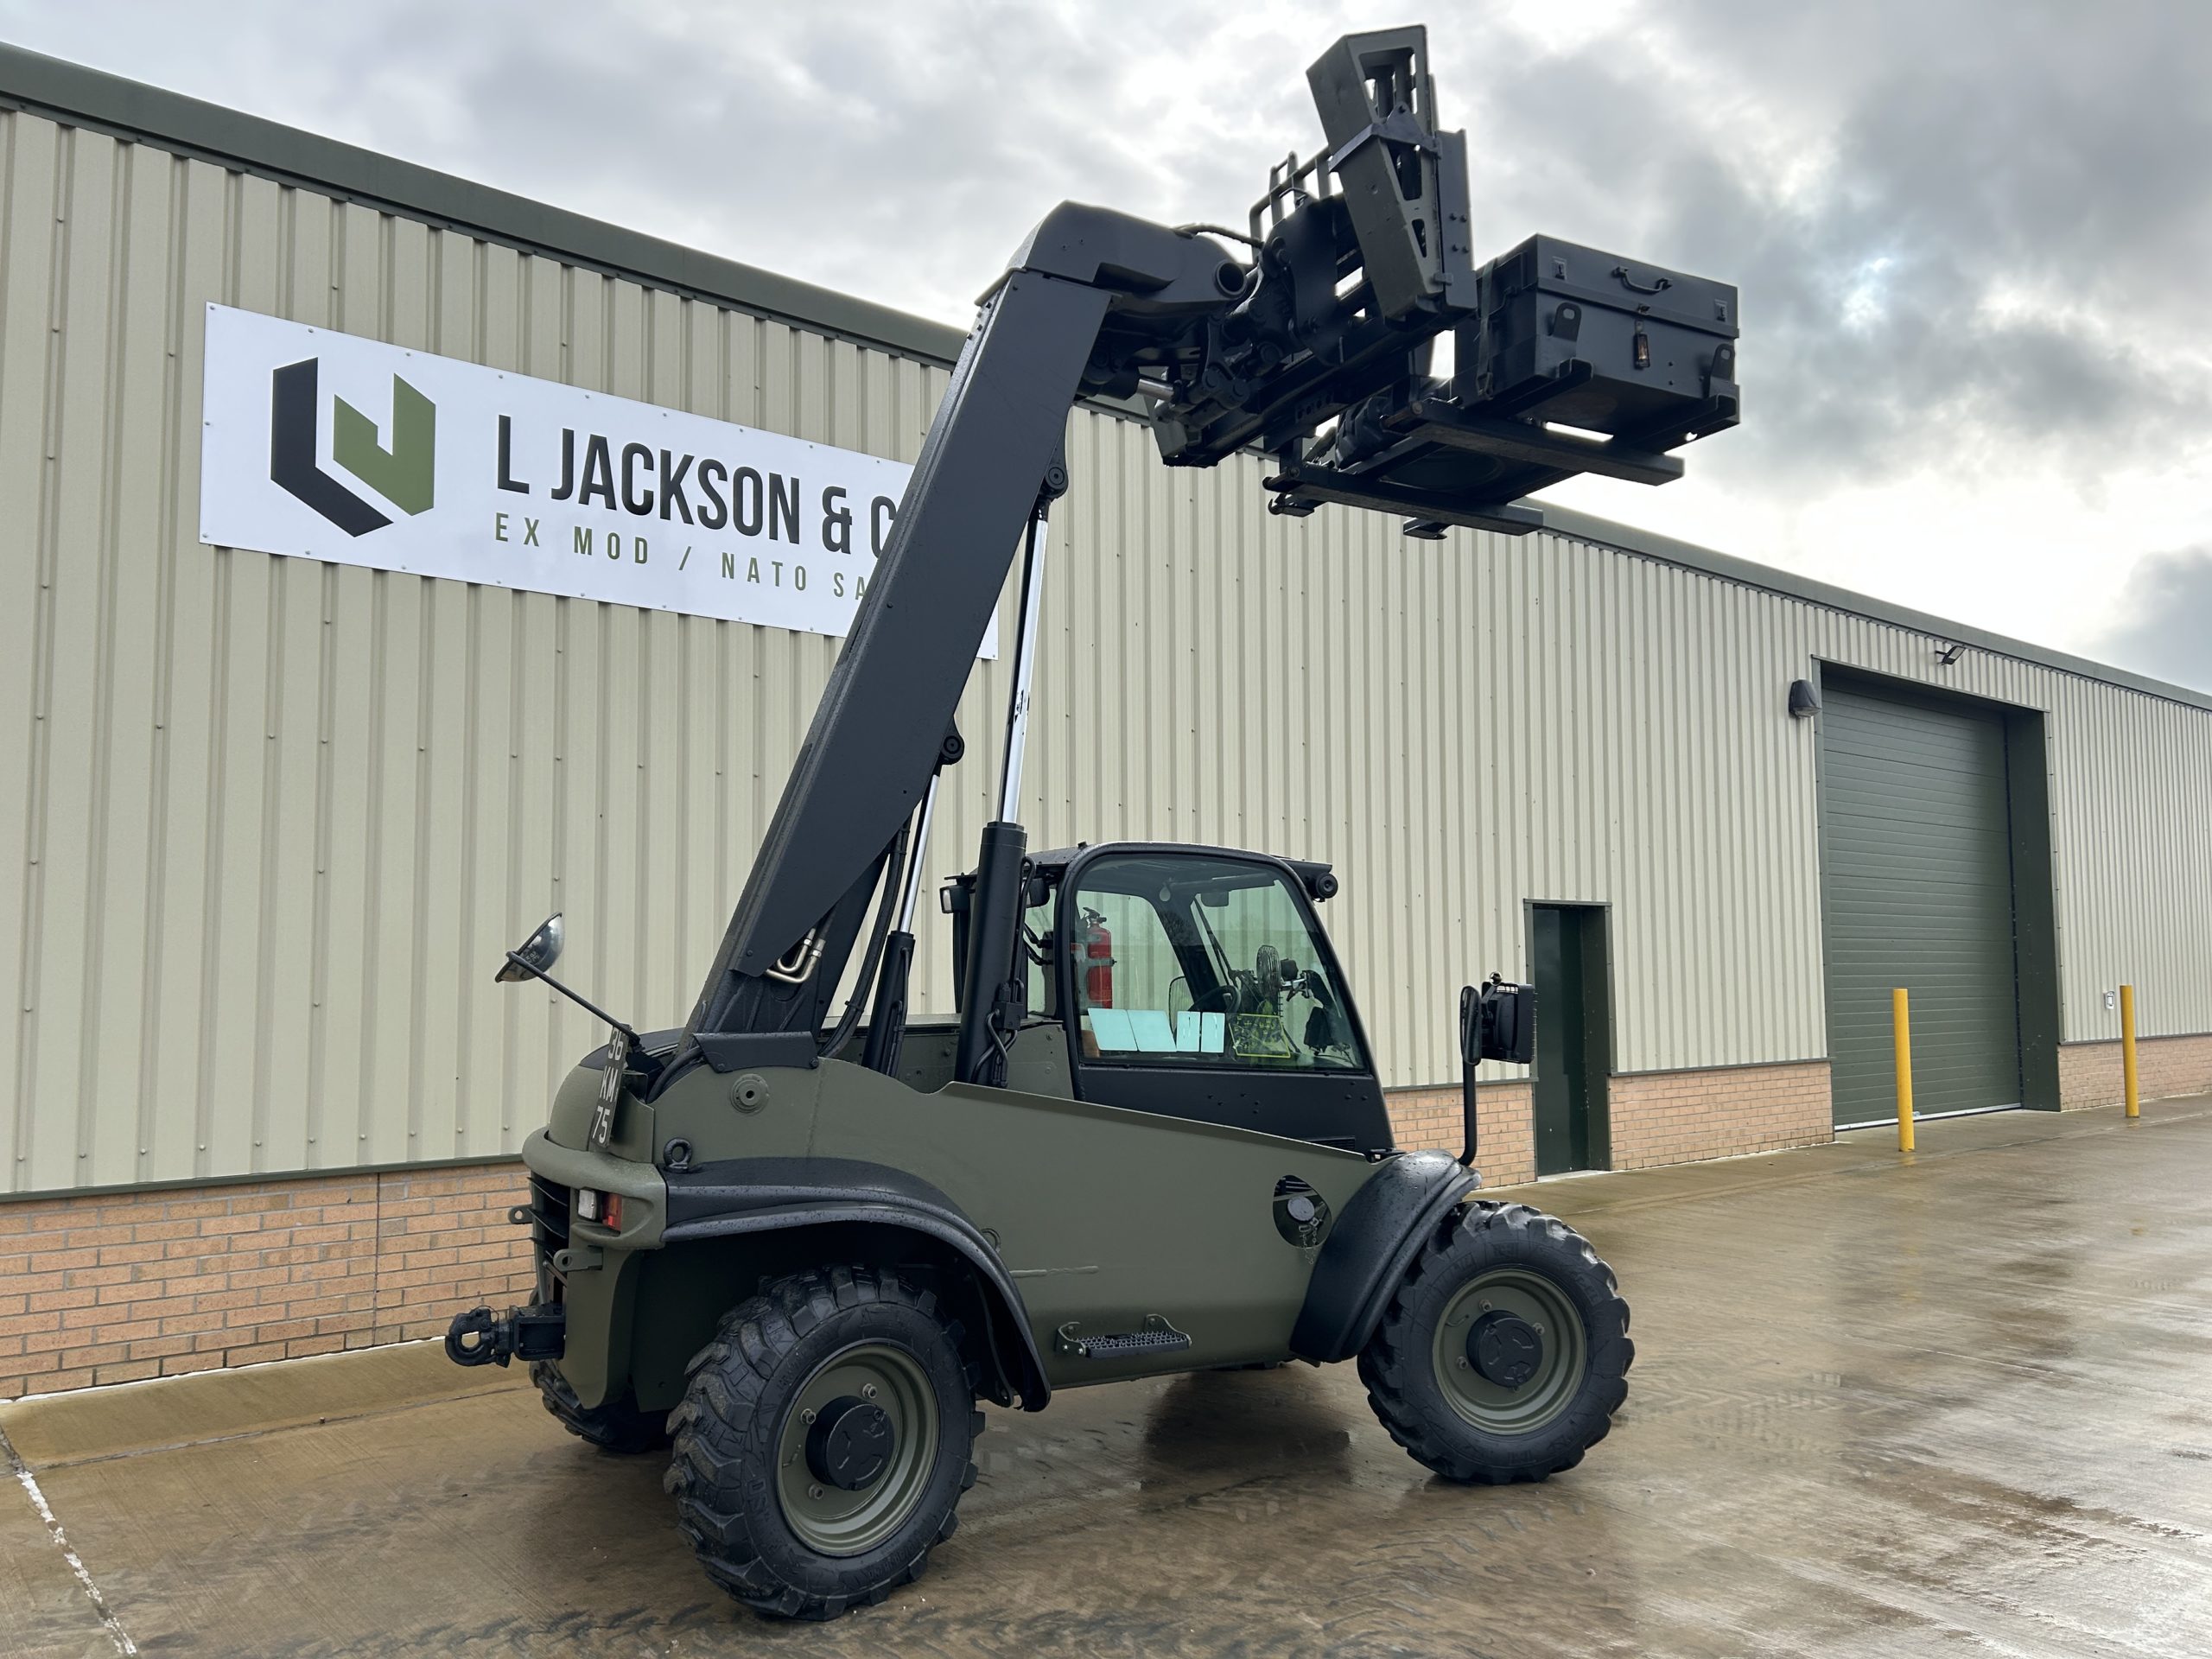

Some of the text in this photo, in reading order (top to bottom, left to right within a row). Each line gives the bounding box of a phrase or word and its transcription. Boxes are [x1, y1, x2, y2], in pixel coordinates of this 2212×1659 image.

[497, 414, 530, 494] L
[550, 428, 800, 544] JACKSON
[822, 486, 853, 555] &
[495, 512, 540, 547] EX
[574, 525, 648, 564] MOD
[678, 545, 692, 571] /
[721, 552, 807, 591] NATO
[607, 1027, 624, 1061] 36
[599, 1065, 619, 1103] KM
[592, 1105, 610, 1144] 75
